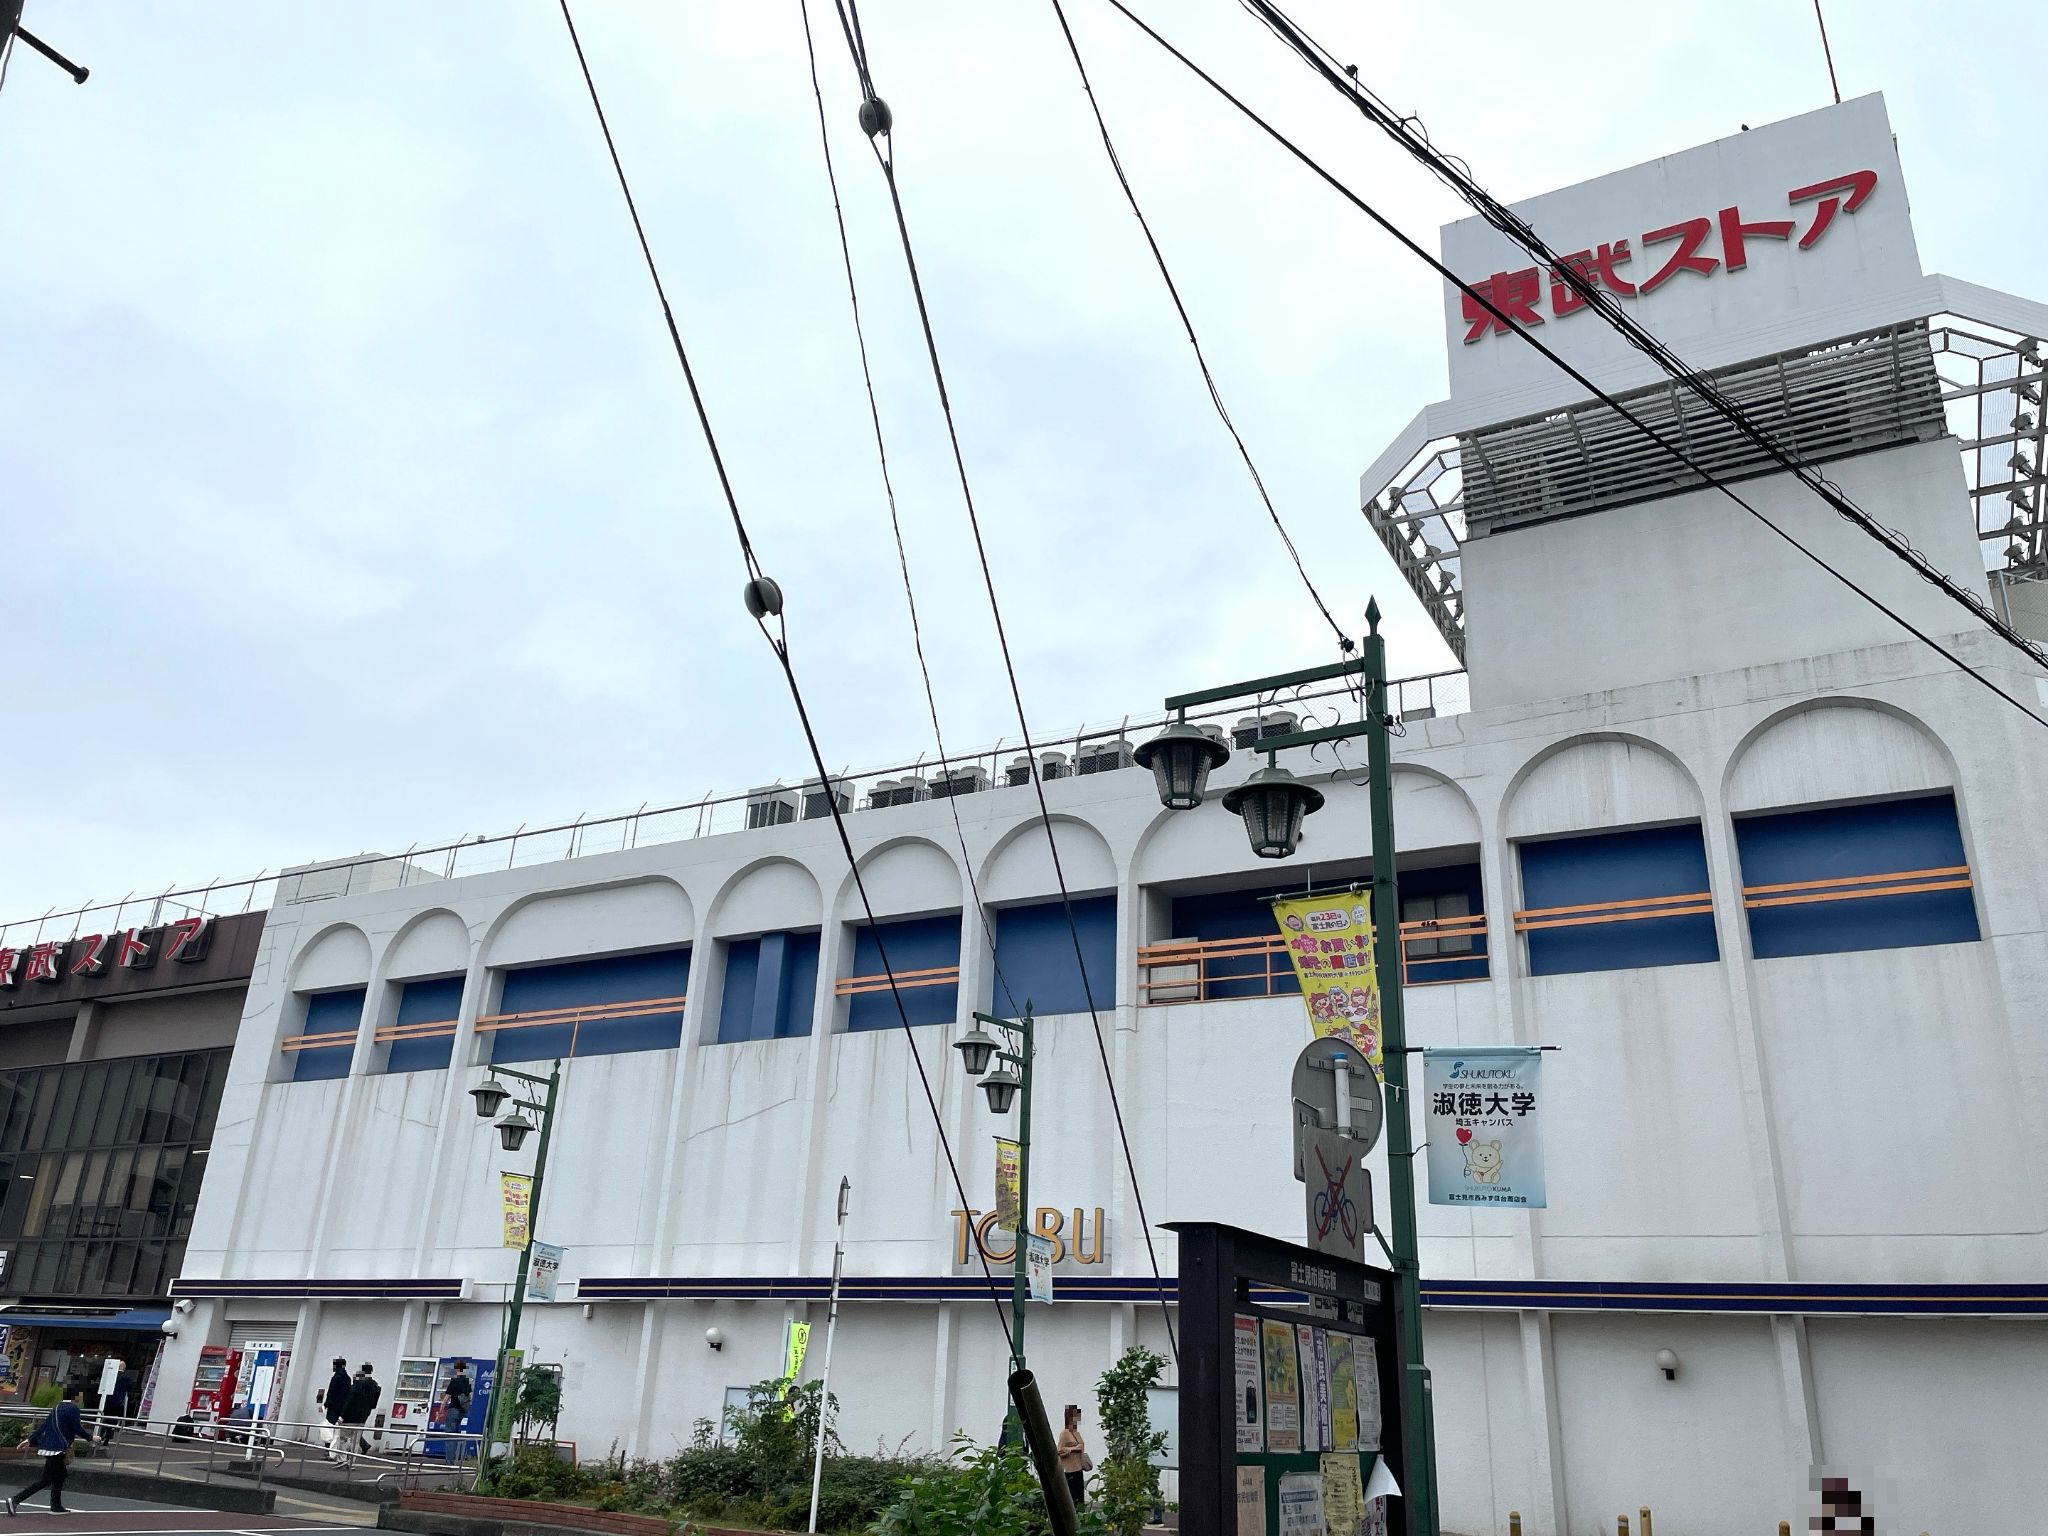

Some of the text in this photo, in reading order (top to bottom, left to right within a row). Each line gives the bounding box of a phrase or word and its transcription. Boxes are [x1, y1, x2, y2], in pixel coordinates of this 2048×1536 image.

[1461, 169, 1878, 345] 東武ストア
[1460, 1069, 1516, 1079] SHUKUTOKU
[1433, 1092, 1536, 1117] 淑徳大学
[1455, 1118, 1514, 1127] 埼玉キャンパス
